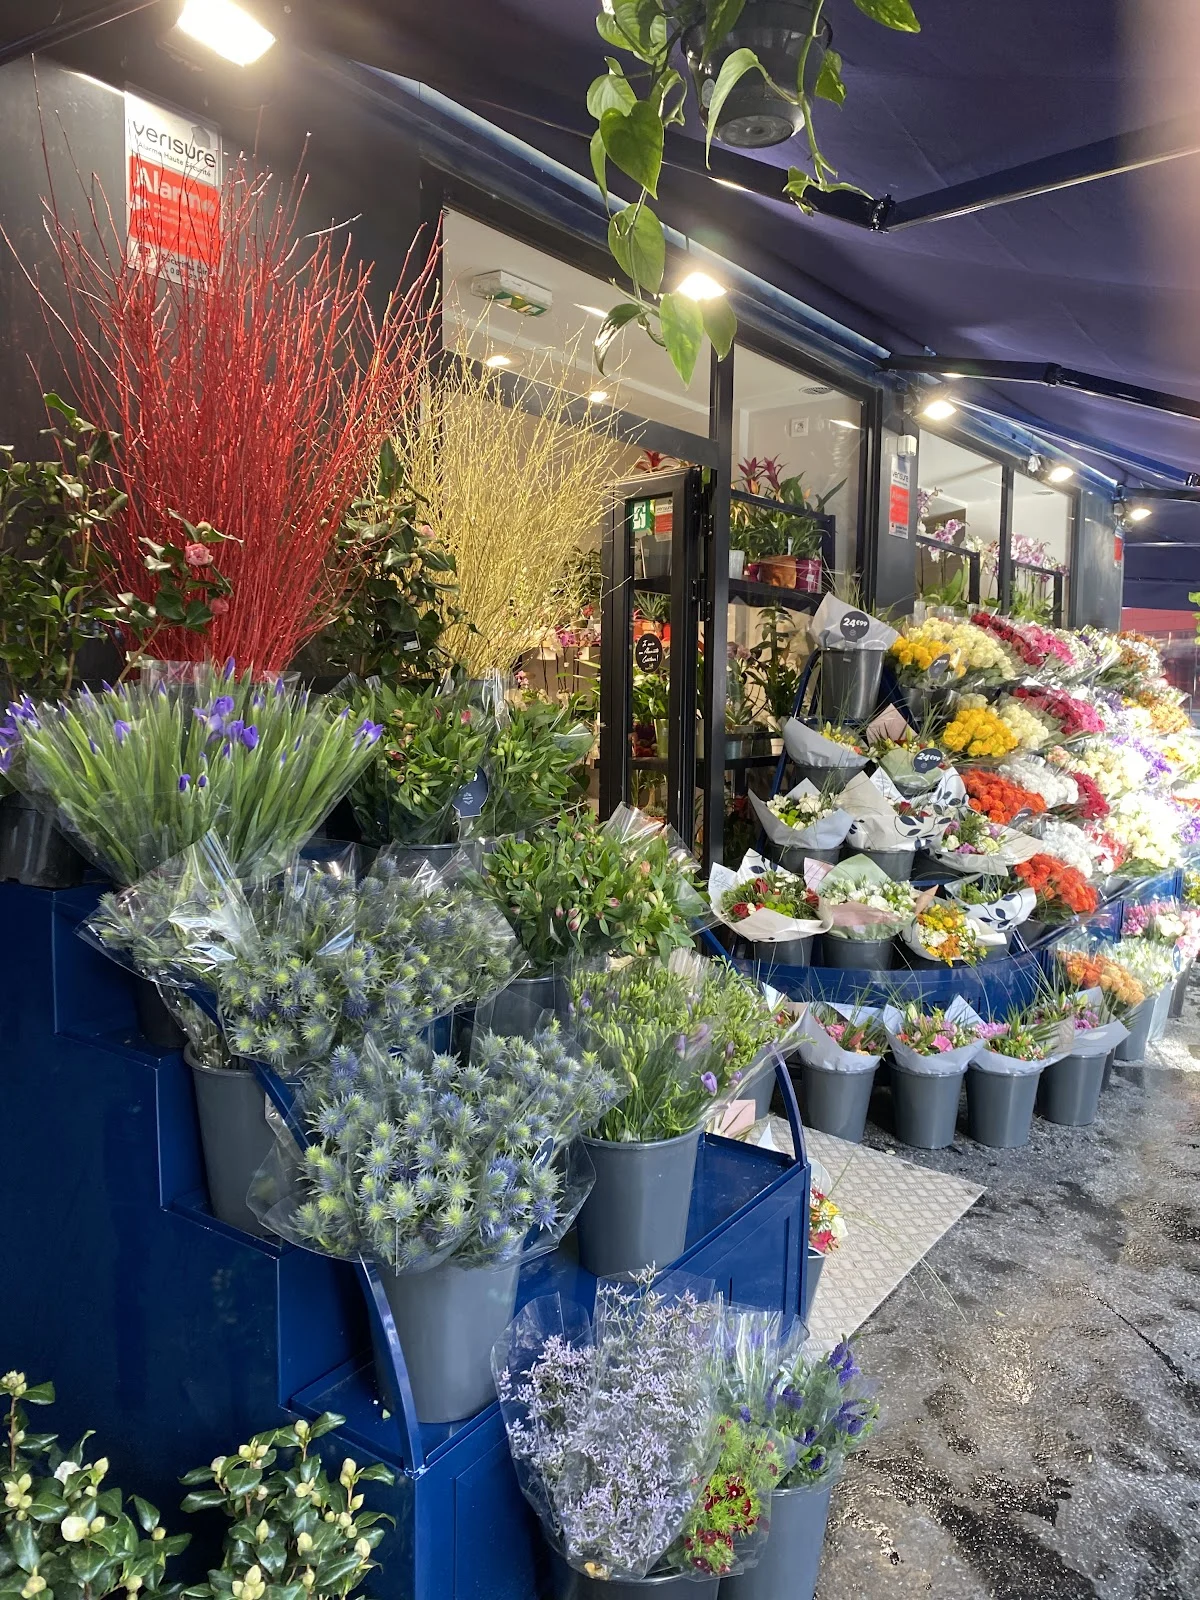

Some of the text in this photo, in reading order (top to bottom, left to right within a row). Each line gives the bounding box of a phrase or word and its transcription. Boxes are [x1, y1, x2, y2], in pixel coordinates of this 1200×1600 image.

[133, 120, 216, 168] verisure
[138, 142, 162, 157] Alarme
[163, 151, 184, 166] Haute
[133, 166, 216, 217] Alarme
[843, 617, 868, 628] 24€99
[917, 752, 941, 762] 24€99
